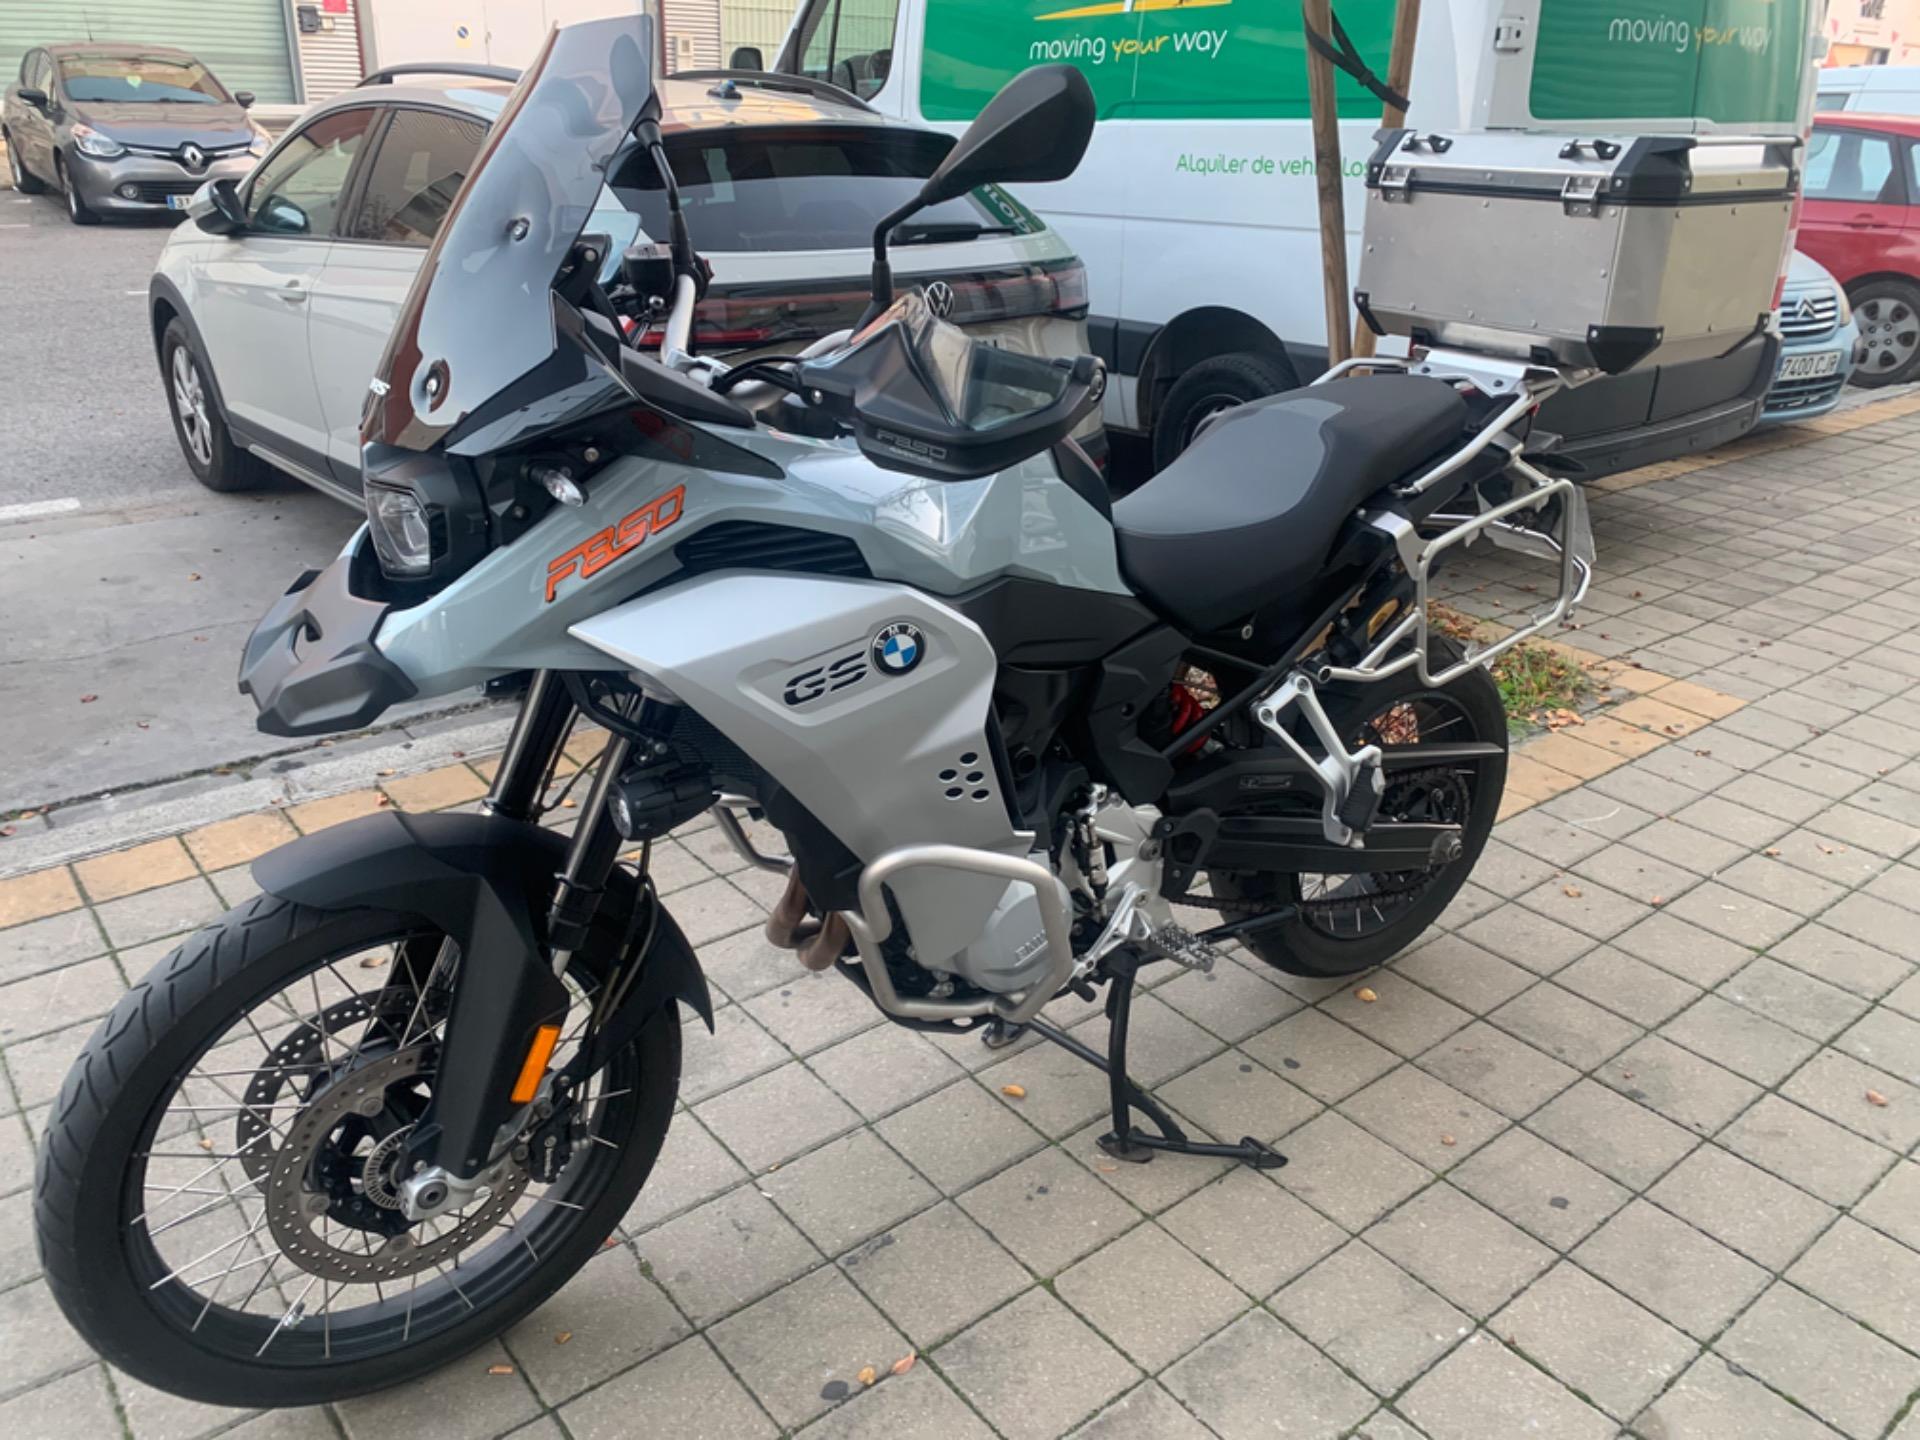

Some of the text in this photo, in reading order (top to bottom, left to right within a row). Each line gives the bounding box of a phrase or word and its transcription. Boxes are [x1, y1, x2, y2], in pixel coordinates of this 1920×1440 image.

[1029, 29, 1227, 64] moving your way
[1609, 14, 1771, 56] moving your way
[1175, 153, 1248, 176] Alquiler
[1252, 156, 1275, 174] de
[545, 484, 686, 603] F850
[784, 650, 867, 706] GS
